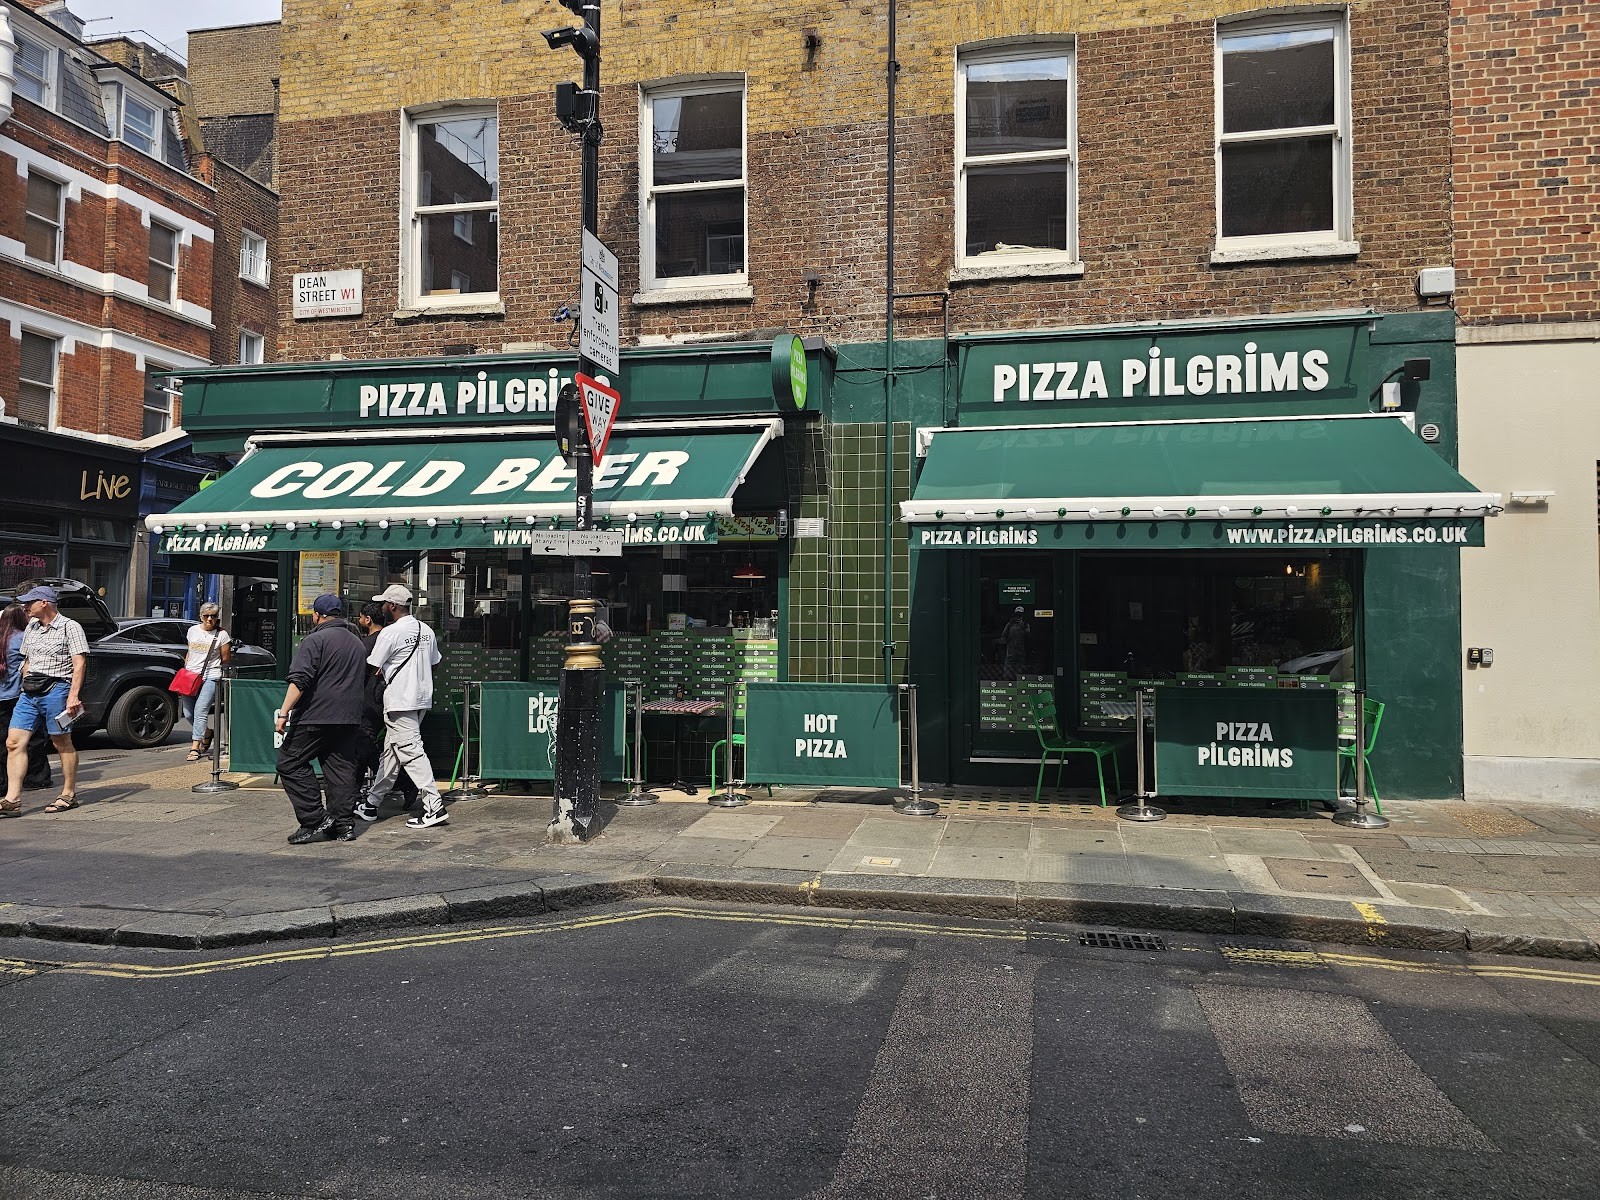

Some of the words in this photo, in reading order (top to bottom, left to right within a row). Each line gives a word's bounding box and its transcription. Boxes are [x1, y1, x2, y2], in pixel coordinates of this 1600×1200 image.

[299, 276, 327, 289] DEAN
[299, 289, 337, 303] STREET
[340, 288, 355, 300] W1
[318, 306, 352, 314] WESTMINSTER
[592, 315, 610, 337] Traffic
[583, 327, 618, 357] enforcement
[589, 345, 612, 367] cameras
[993, 360, 1109, 403] PIZZA
[359, 382, 448, 418] PIZZA
[457, 367, 611, 414] PILGRI
[587, 390, 610, 415] GIVE
[592, 413, 607, 429] WAY
[250, 460, 466, 499] COLD
[470, 450, 690, 496] BEER
[80, 470, 132, 501] Live
[166, 534, 201, 552] PIZZA
[921, 530, 963, 545] PIZZA
[804, 714, 838, 733] HOT
[1216, 722, 1274, 742] PIZZA
[795, 738, 848, 758] PIZZA
